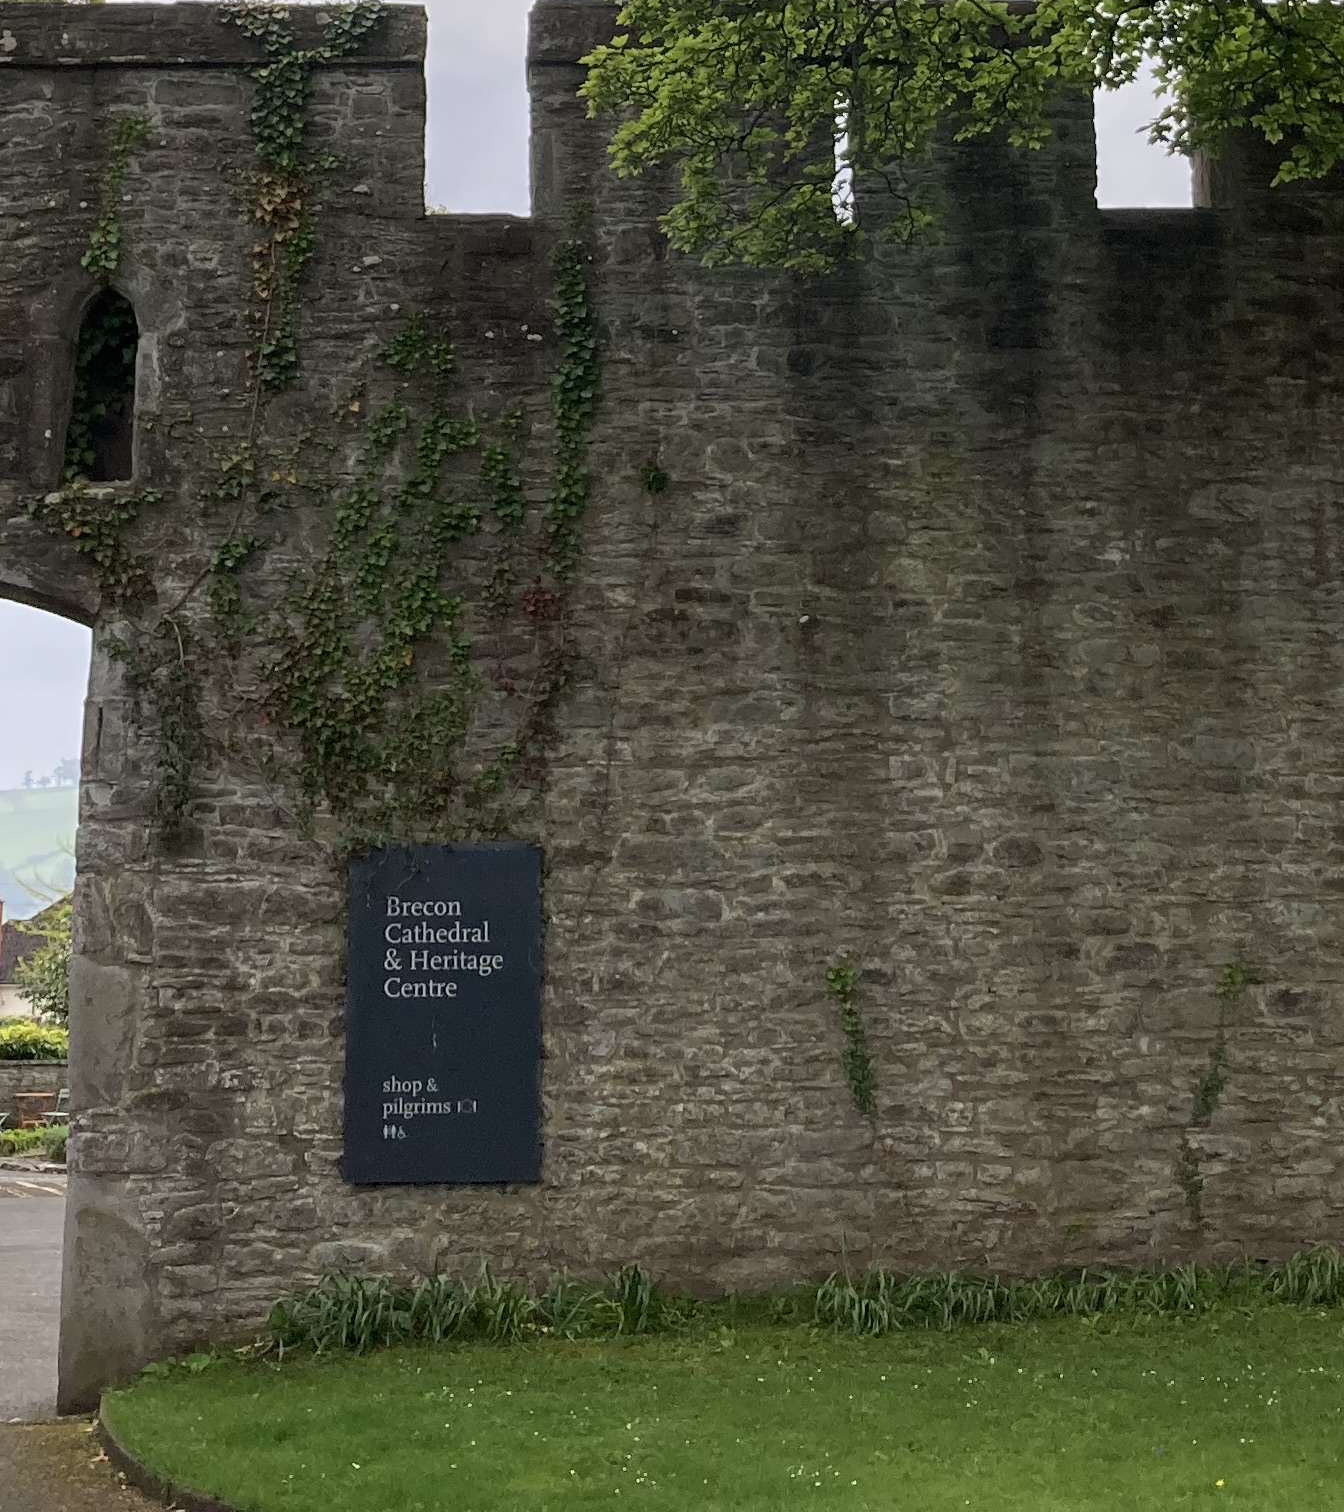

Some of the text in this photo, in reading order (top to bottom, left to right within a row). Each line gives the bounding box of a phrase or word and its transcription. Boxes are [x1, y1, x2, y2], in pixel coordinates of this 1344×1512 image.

[386, 896, 461, 916] Brecon
[385, 921, 490, 943] Cathedral
[384, 948, 504, 976] & Heritage
[384, 977, 457, 998] Centre
[382, 1074, 439, 1097] shop &
[382, 1096, 451, 1120] pilgrims
